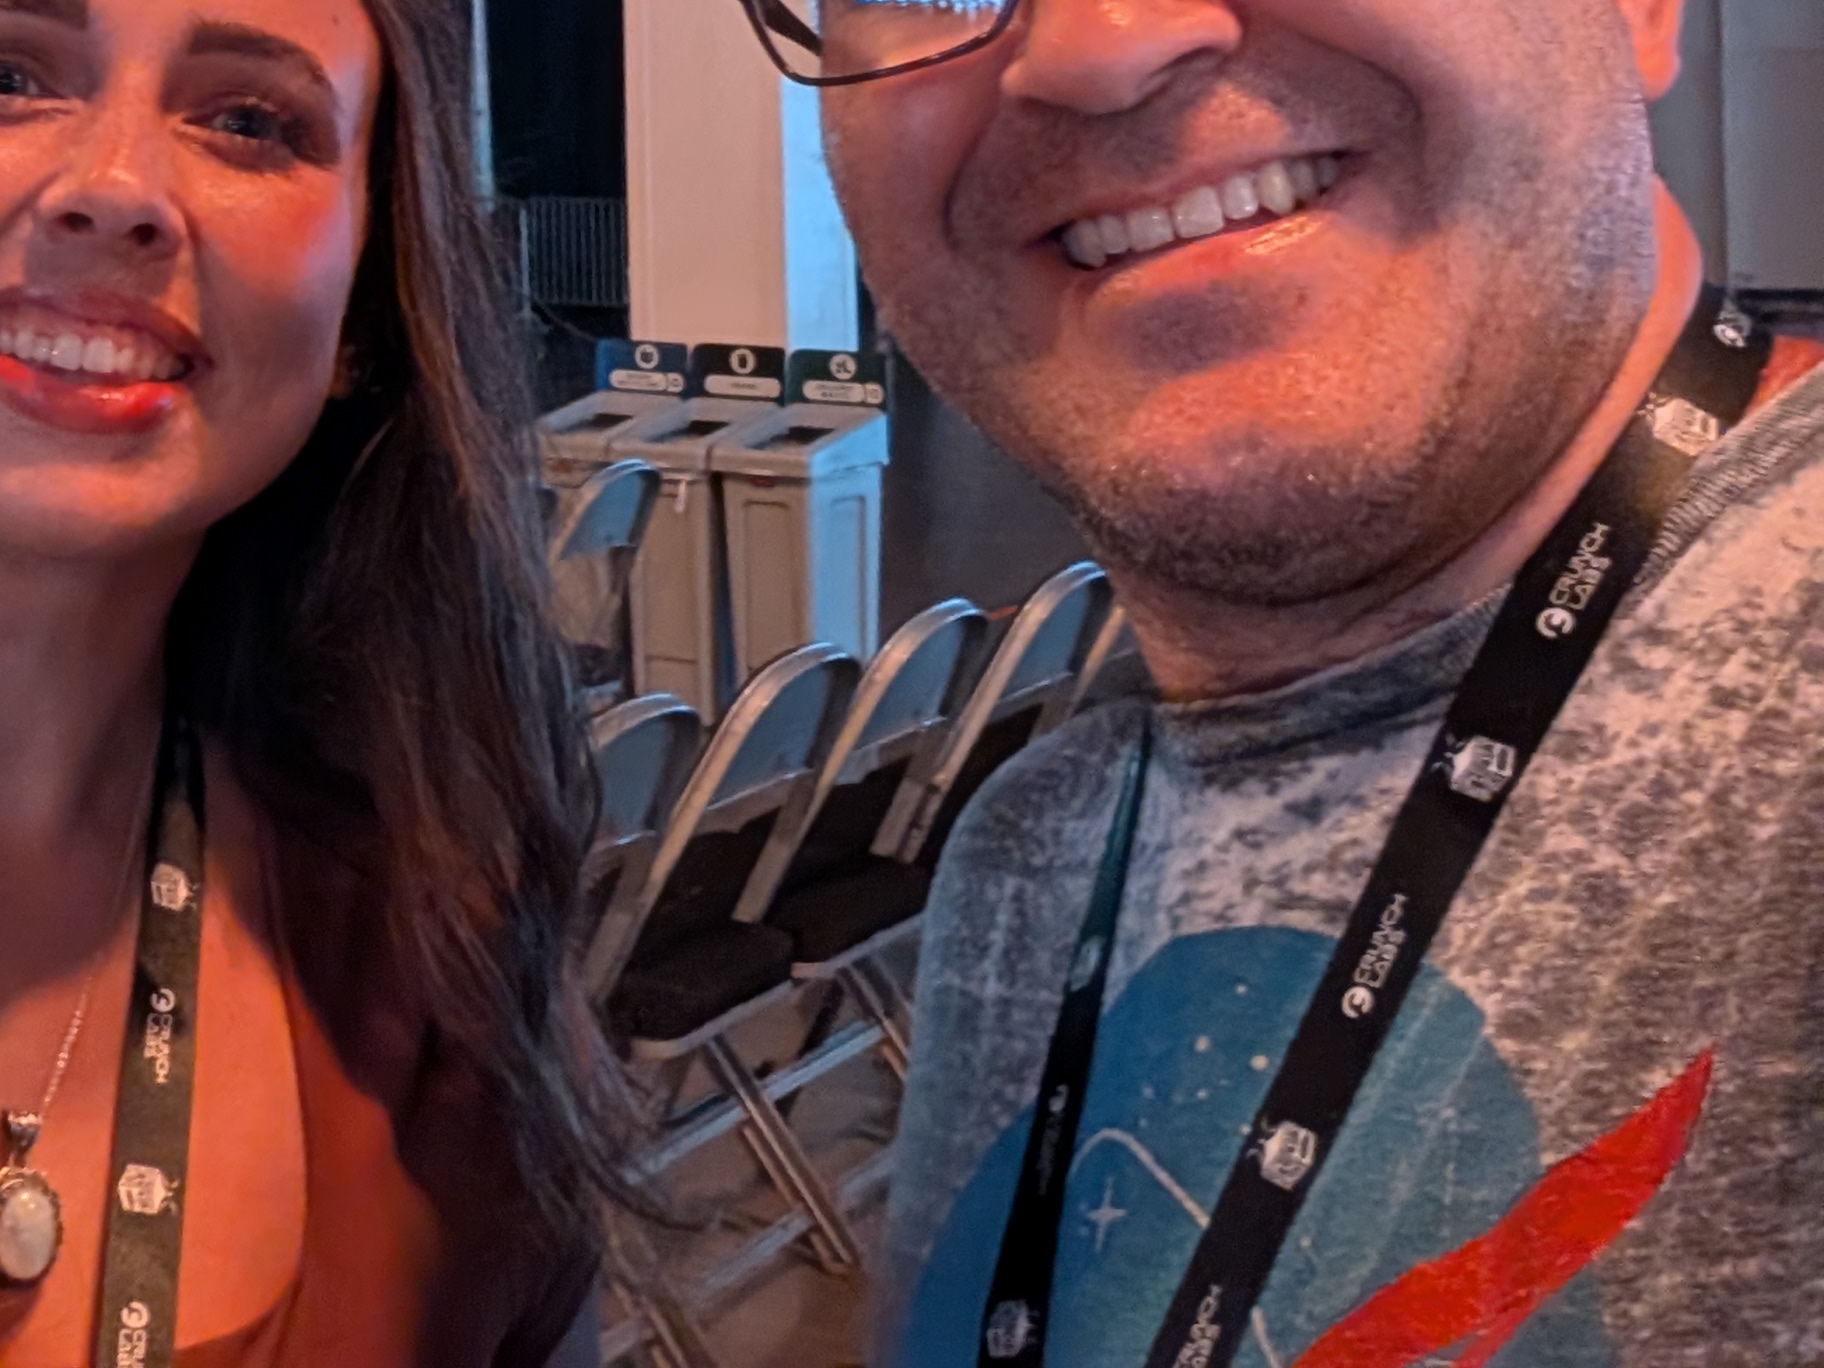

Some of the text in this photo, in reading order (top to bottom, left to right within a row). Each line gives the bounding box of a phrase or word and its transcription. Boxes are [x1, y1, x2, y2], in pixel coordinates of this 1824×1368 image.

[1548, 521, 1610, 604] CRUNCH
[1567, 556, 1612, 610] LABS
[1353, 893, 1408, 984] CRUNCH
[1369, 930, 1406, 988] LABS
